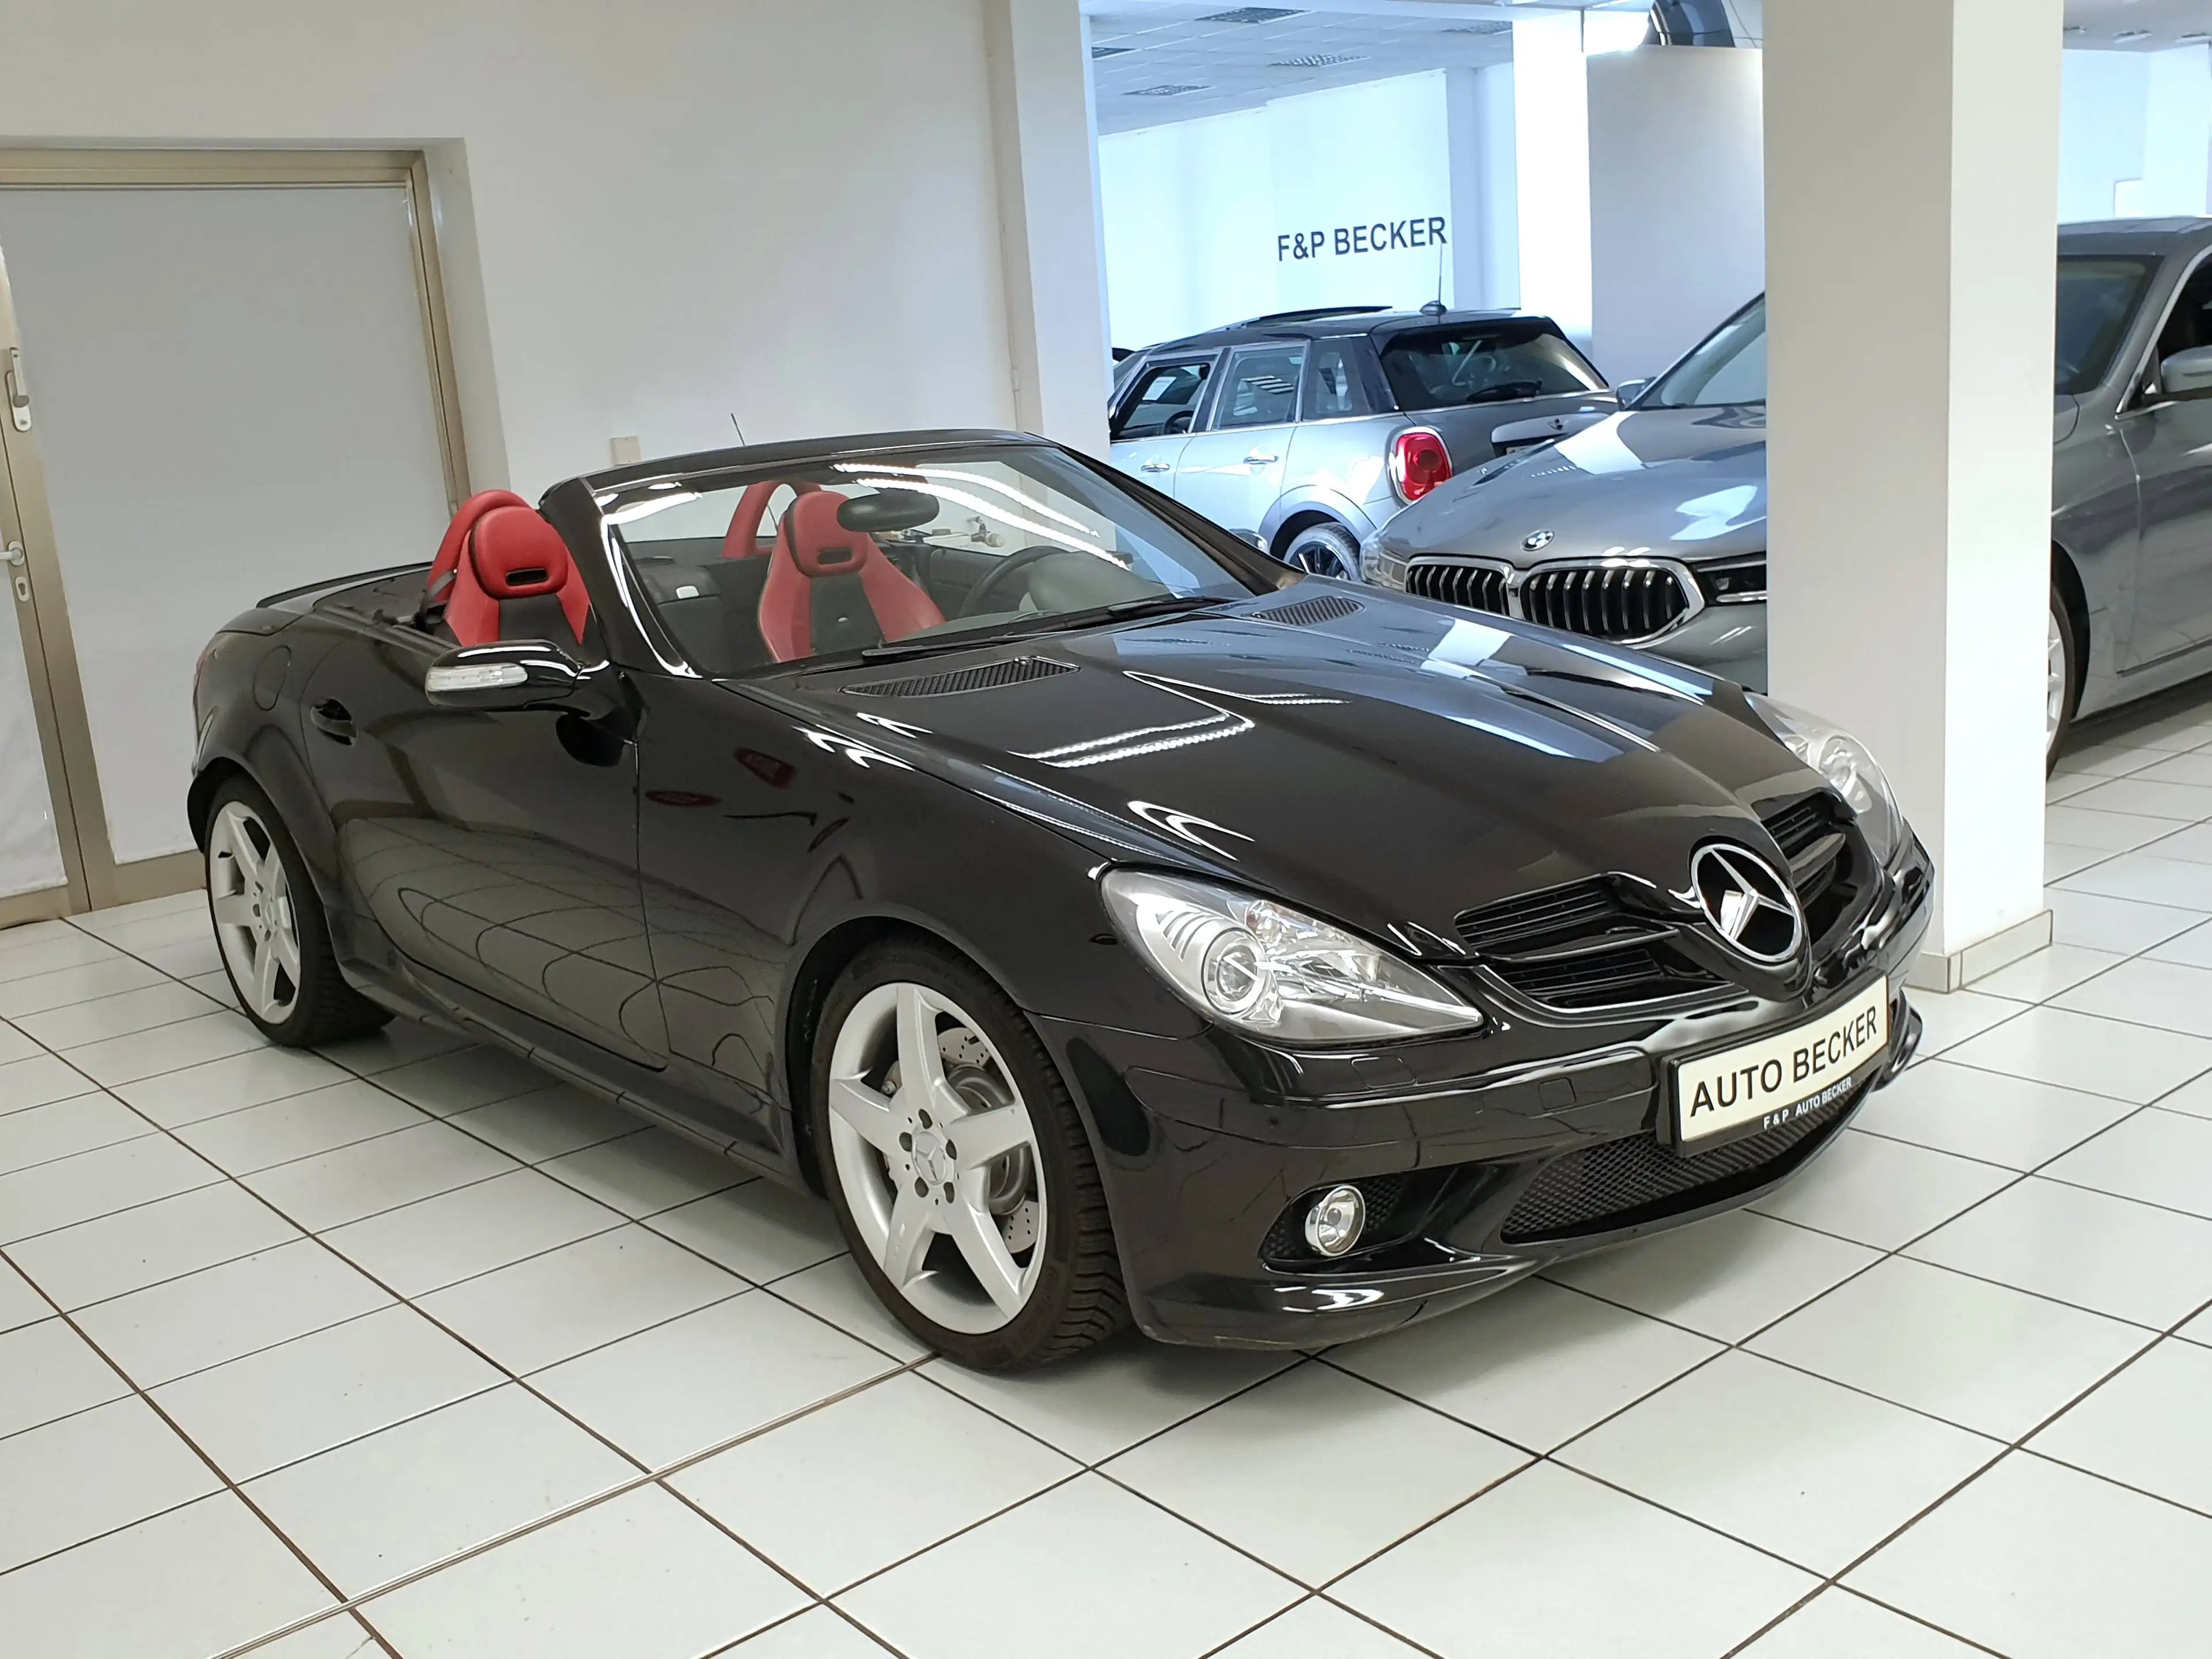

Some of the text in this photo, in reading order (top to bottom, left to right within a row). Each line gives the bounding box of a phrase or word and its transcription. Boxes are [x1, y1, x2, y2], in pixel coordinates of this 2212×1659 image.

[1277, 216, 1448, 262] F&P BECKER
[1690, 1005, 1877, 1118] AUTO BECKER
[1763, 1076, 1852, 1130] F & P AUTO BECKER
